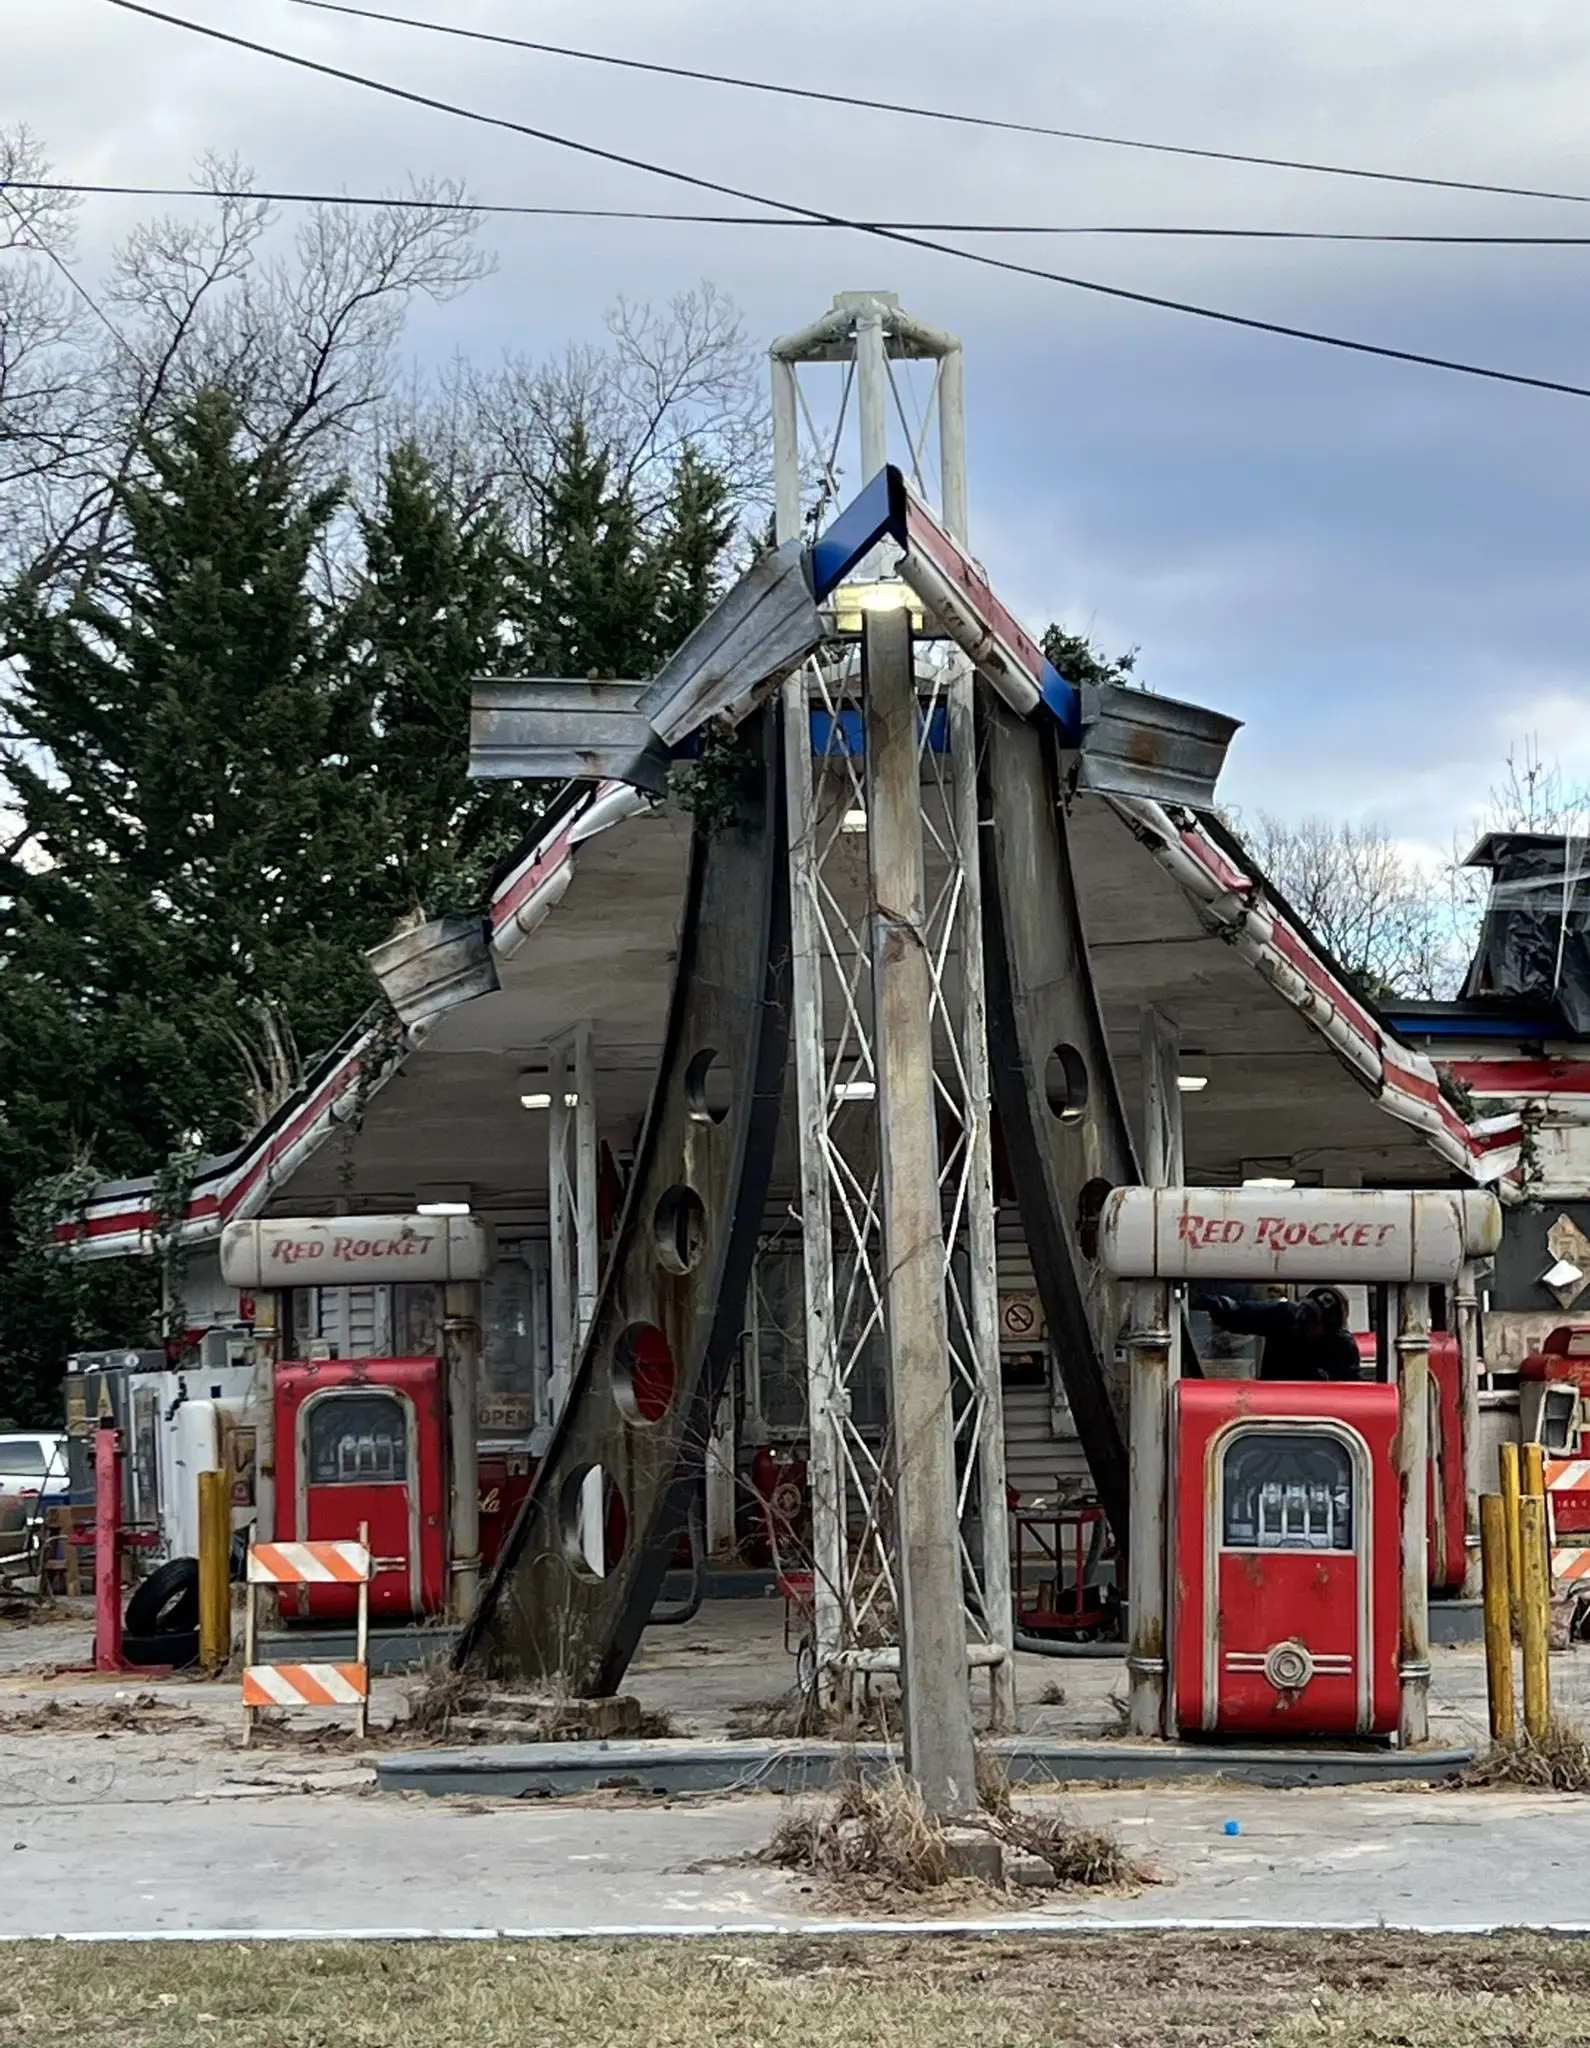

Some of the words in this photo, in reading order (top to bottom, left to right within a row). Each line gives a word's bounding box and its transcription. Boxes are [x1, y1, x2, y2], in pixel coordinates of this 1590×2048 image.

[1177, 1215, 1245, 1250] RED
[1254, 1217, 1396, 1251] ROCKET
[271, 1239, 325, 1264] RED
[332, 1235, 434, 1262] ROCKET
